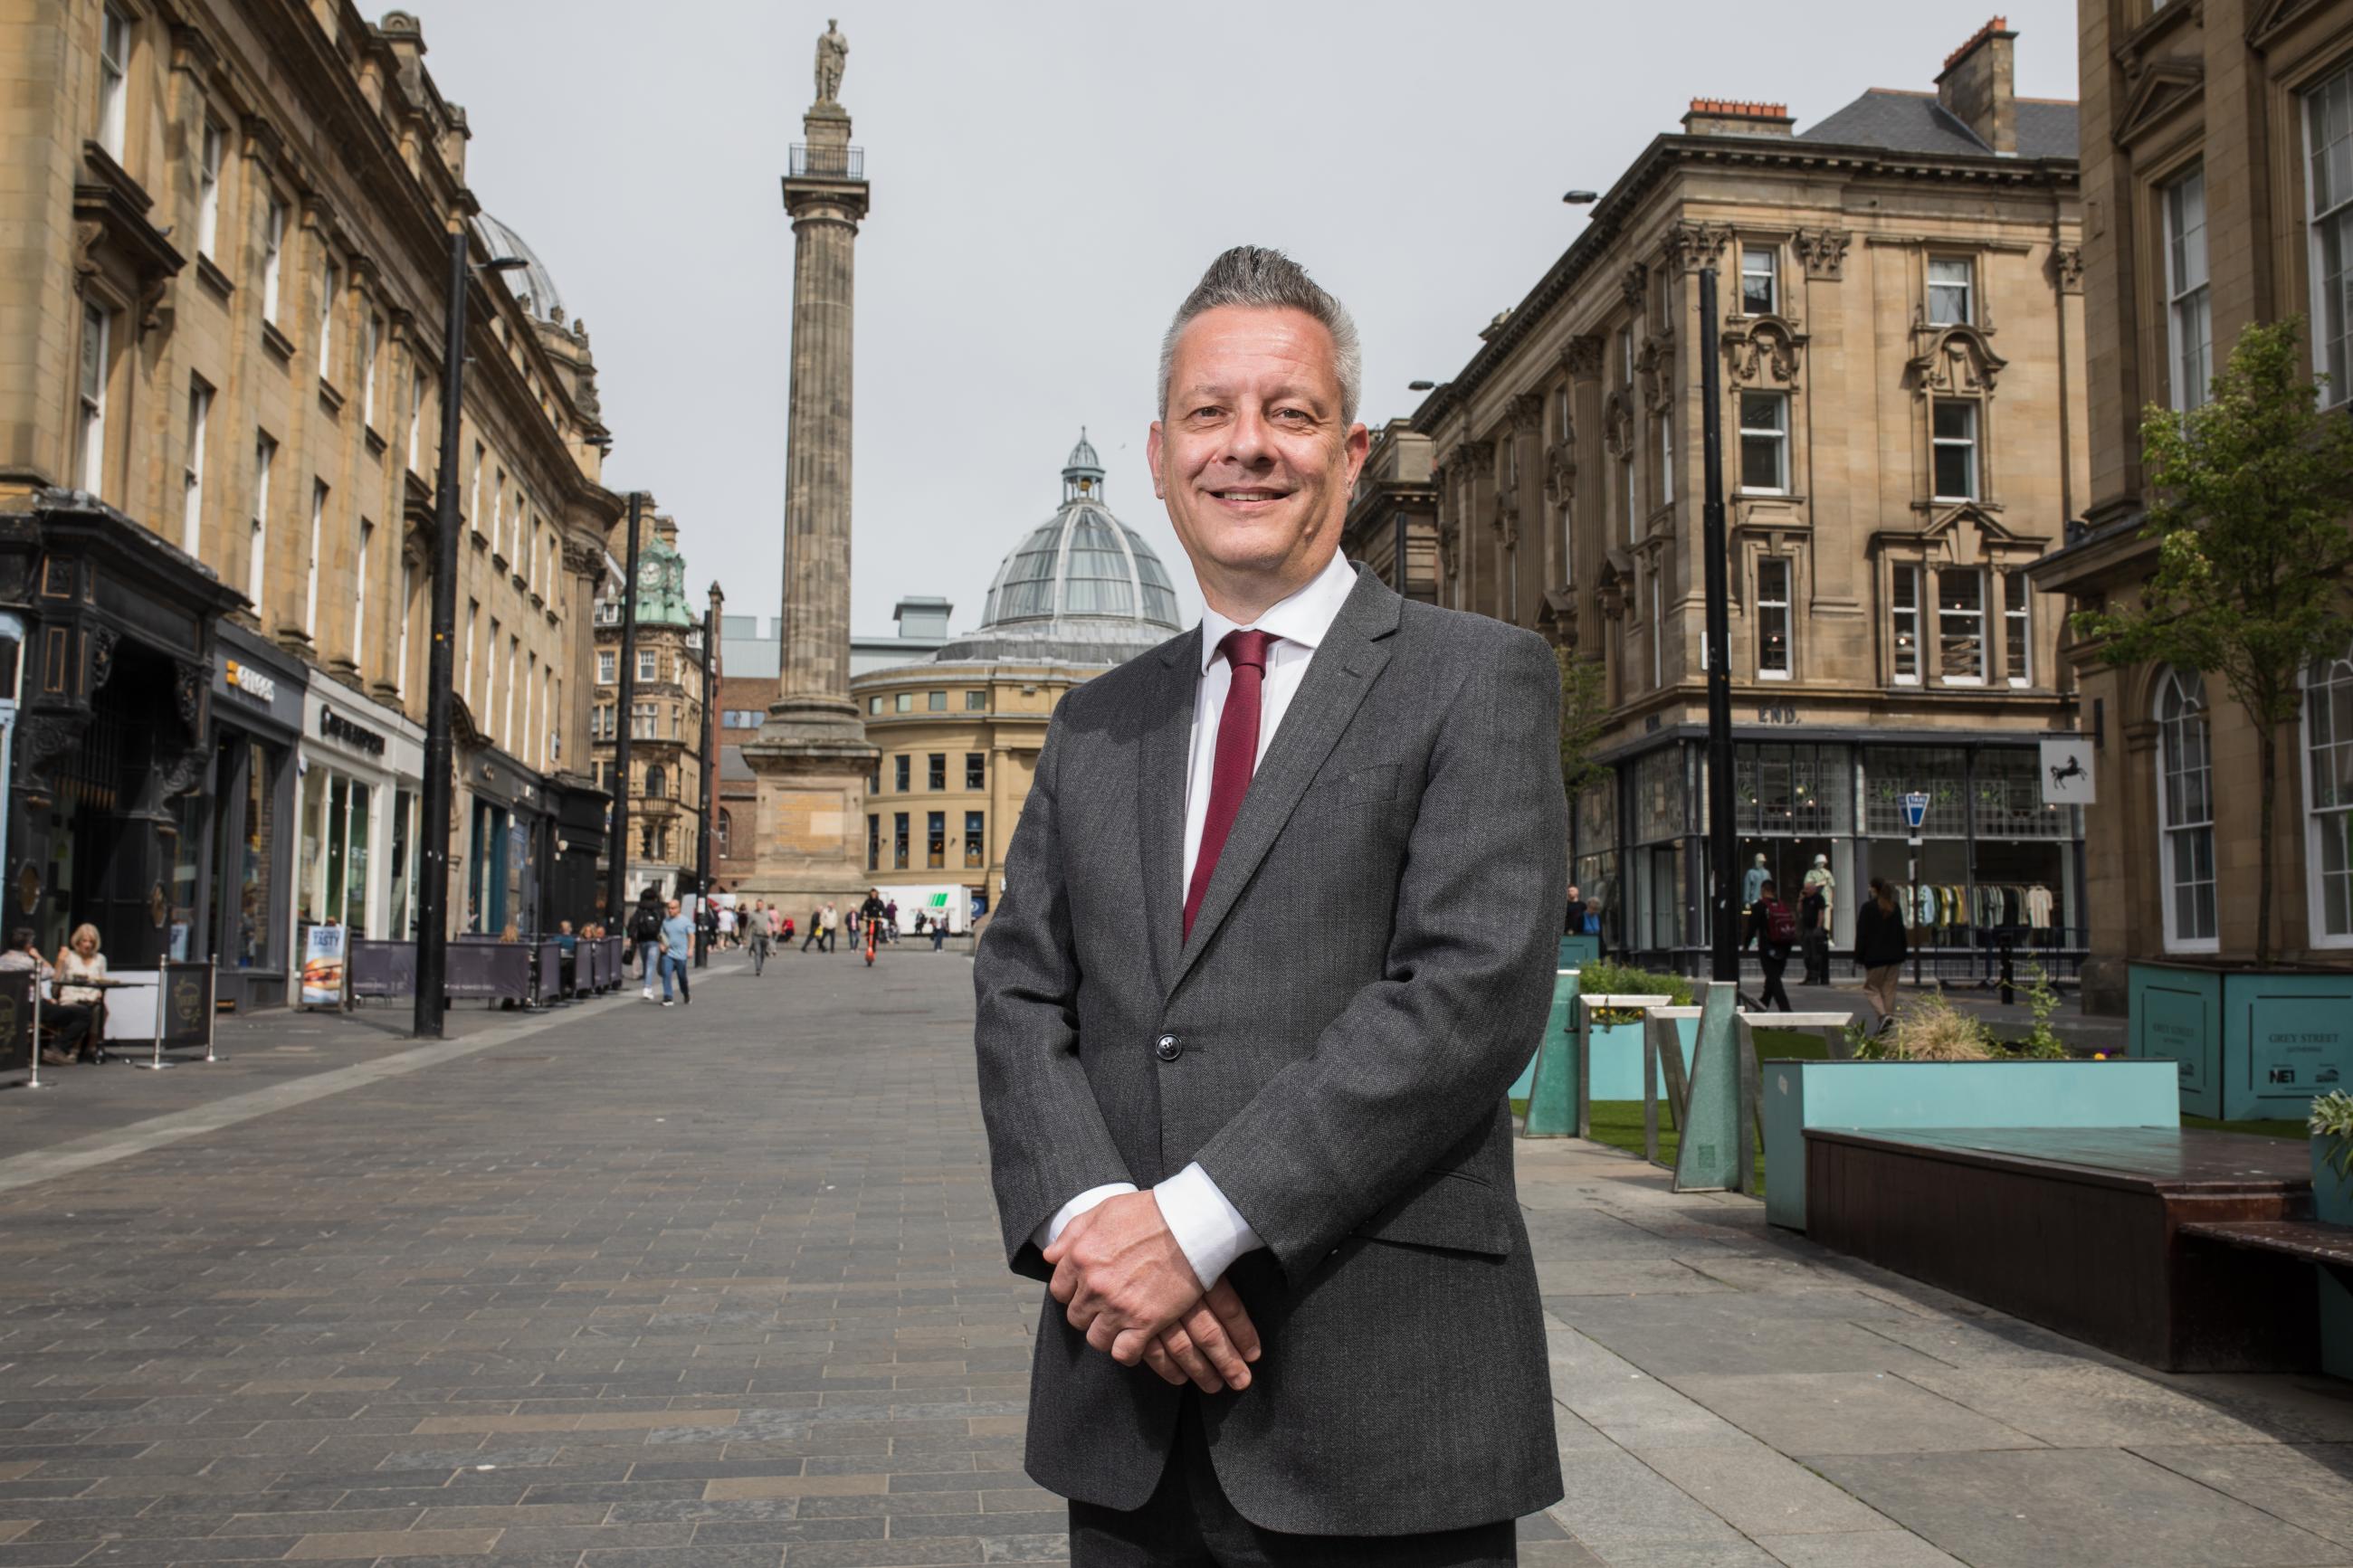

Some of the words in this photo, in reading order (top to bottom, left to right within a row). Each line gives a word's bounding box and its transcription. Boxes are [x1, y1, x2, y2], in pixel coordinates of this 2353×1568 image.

[313, 936, 339, 946] TASTY
[2269, 1033, 2298, 1043] GREY
[2301, 1033, 2339, 1043] STREET
[2269, 1069, 2295, 1083] NE1
